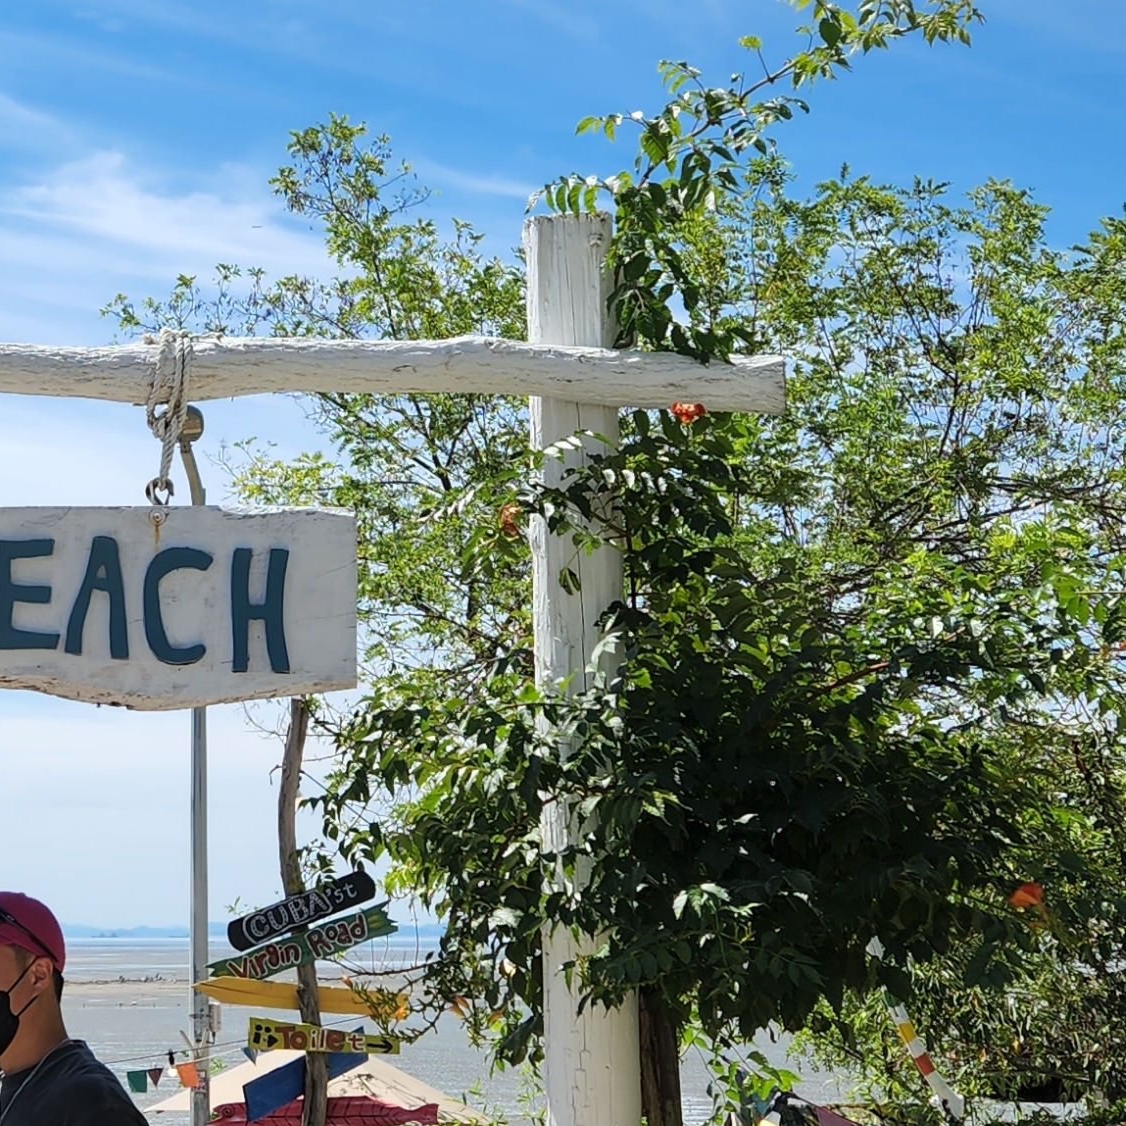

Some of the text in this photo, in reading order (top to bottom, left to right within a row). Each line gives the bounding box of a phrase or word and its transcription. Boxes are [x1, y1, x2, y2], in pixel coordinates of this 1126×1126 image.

[226, 913, 367, 978] Virgin Road
[275, 1026, 366, 1052] Toilet
